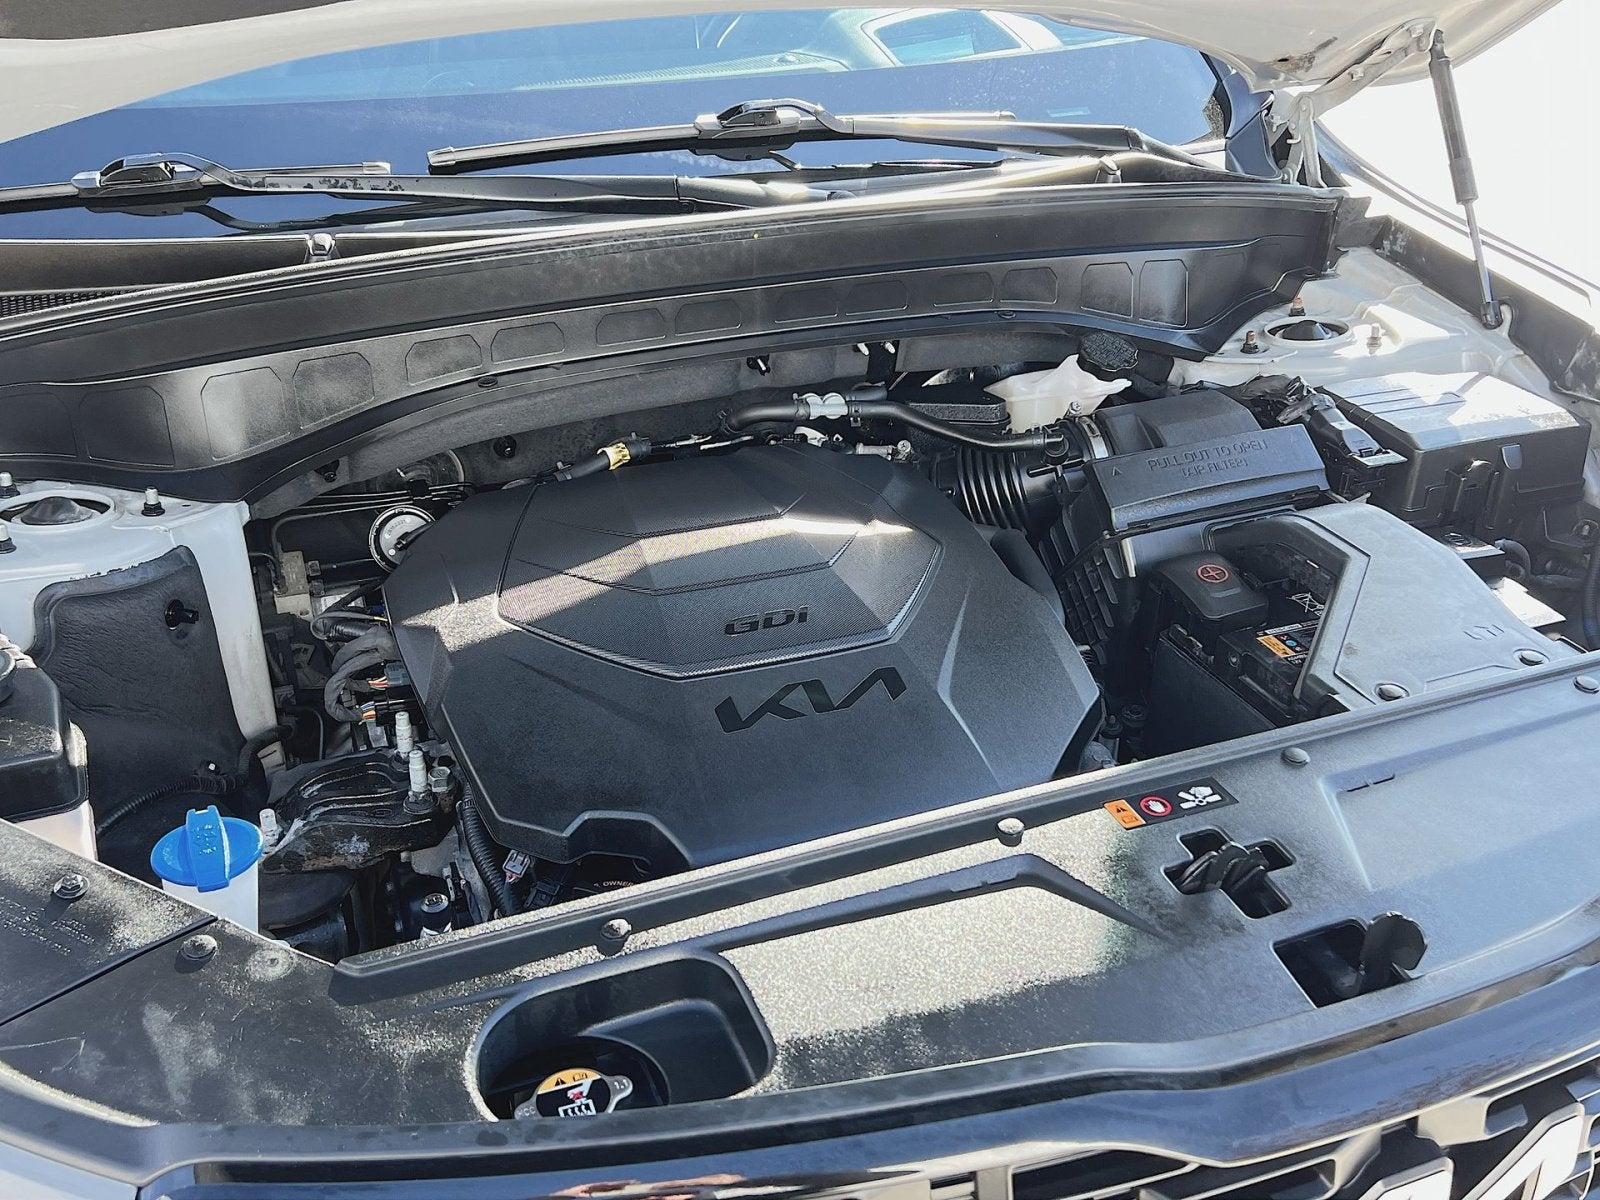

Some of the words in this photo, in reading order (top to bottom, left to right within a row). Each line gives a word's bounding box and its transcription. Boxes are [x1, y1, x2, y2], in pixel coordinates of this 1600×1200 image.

[1147, 455, 1183, 471] PULL
[1183, 449, 1210, 464] OUT
[1212, 446, 1231, 458] TO
[1232, 439, 1269, 454] OPEN
[714, 666, 907, 734] KIA
